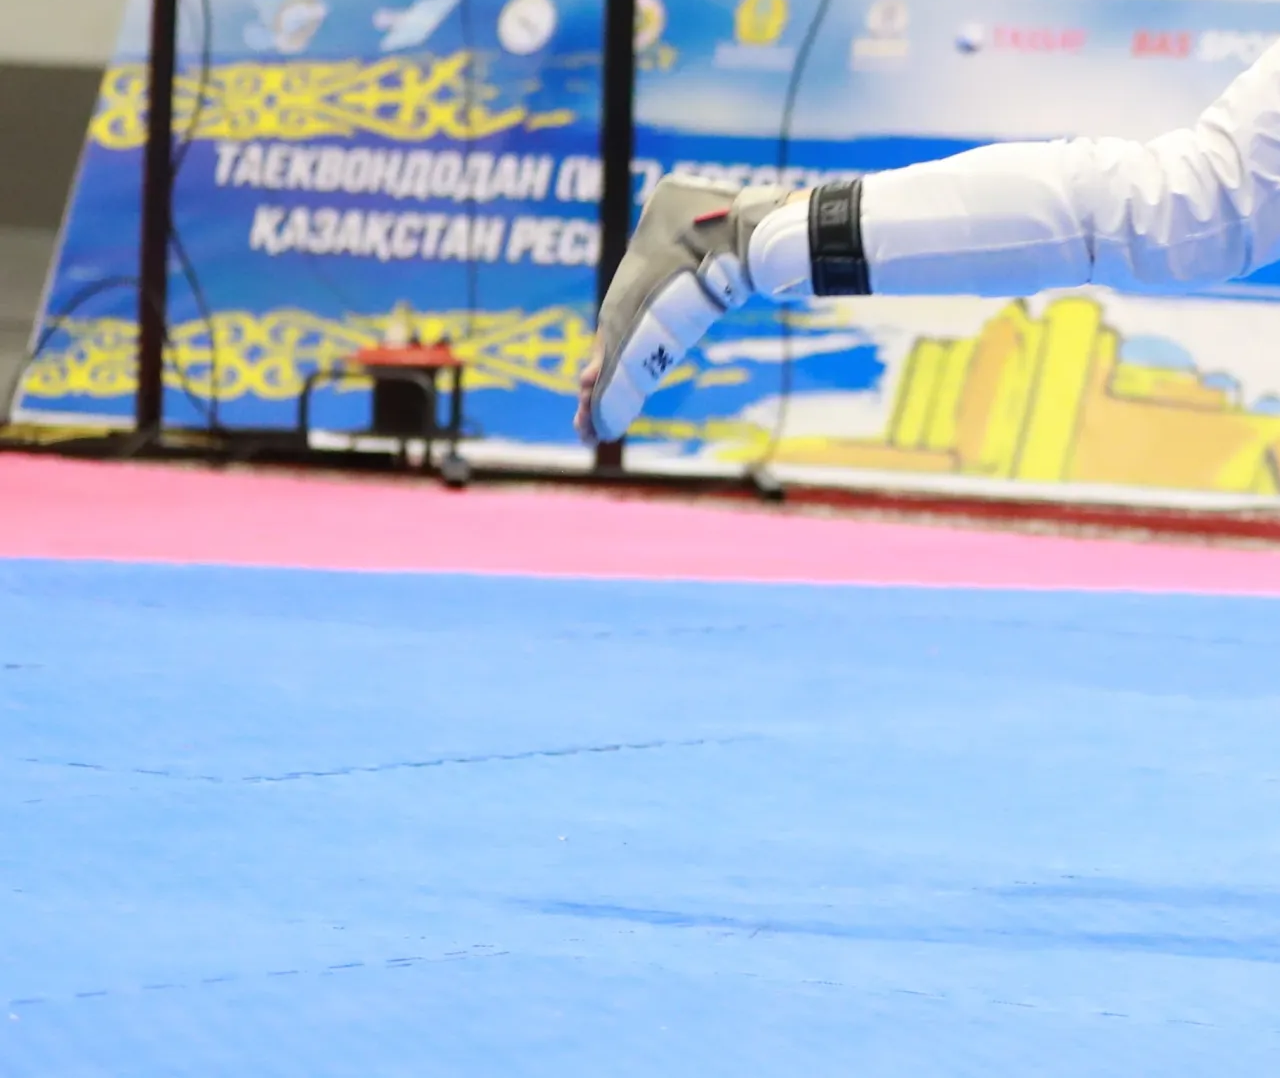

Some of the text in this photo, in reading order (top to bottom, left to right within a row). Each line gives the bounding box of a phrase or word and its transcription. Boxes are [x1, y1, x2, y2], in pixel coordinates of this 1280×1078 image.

[214, 142, 553, 204] ТАЕКВОНДОДАН
[250, 203, 602, 266] ҚАЗАҚСТАН РЕС
